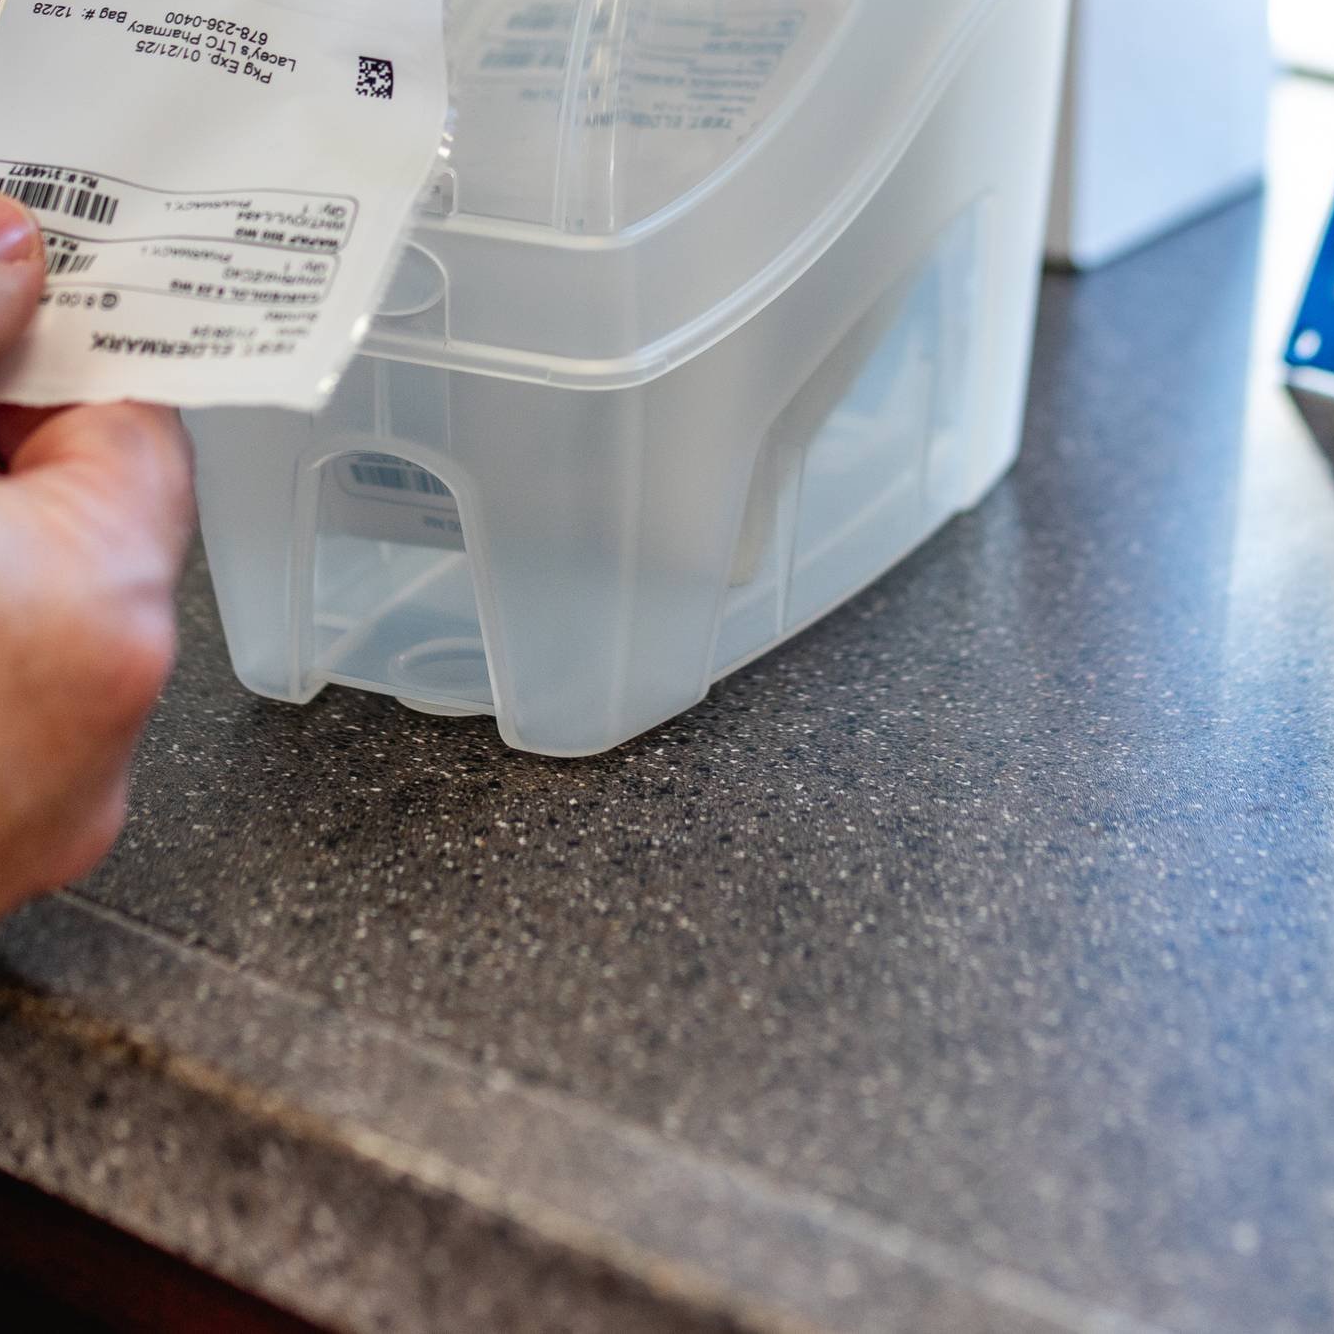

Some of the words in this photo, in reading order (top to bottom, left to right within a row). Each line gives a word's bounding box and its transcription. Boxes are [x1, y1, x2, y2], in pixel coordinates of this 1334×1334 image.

[33, 2, 73, 18] 12/28
[81, 8, 95, 20] #:
[99, 8, 128, 24] Bag
[127, 20, 202, 44] Pharmacy
[165, 12, 269, 46] 678-236-0400
[135, 40, 201, 62] 01/21/25
[205, 36, 237, 54] LTC
[207, 52, 239, 74] Exp.
[240, 45, 297, 72] Lacey's
[243, 62, 273, 84] Pkg
[88, 333, 235, 358] ELDERMARK
